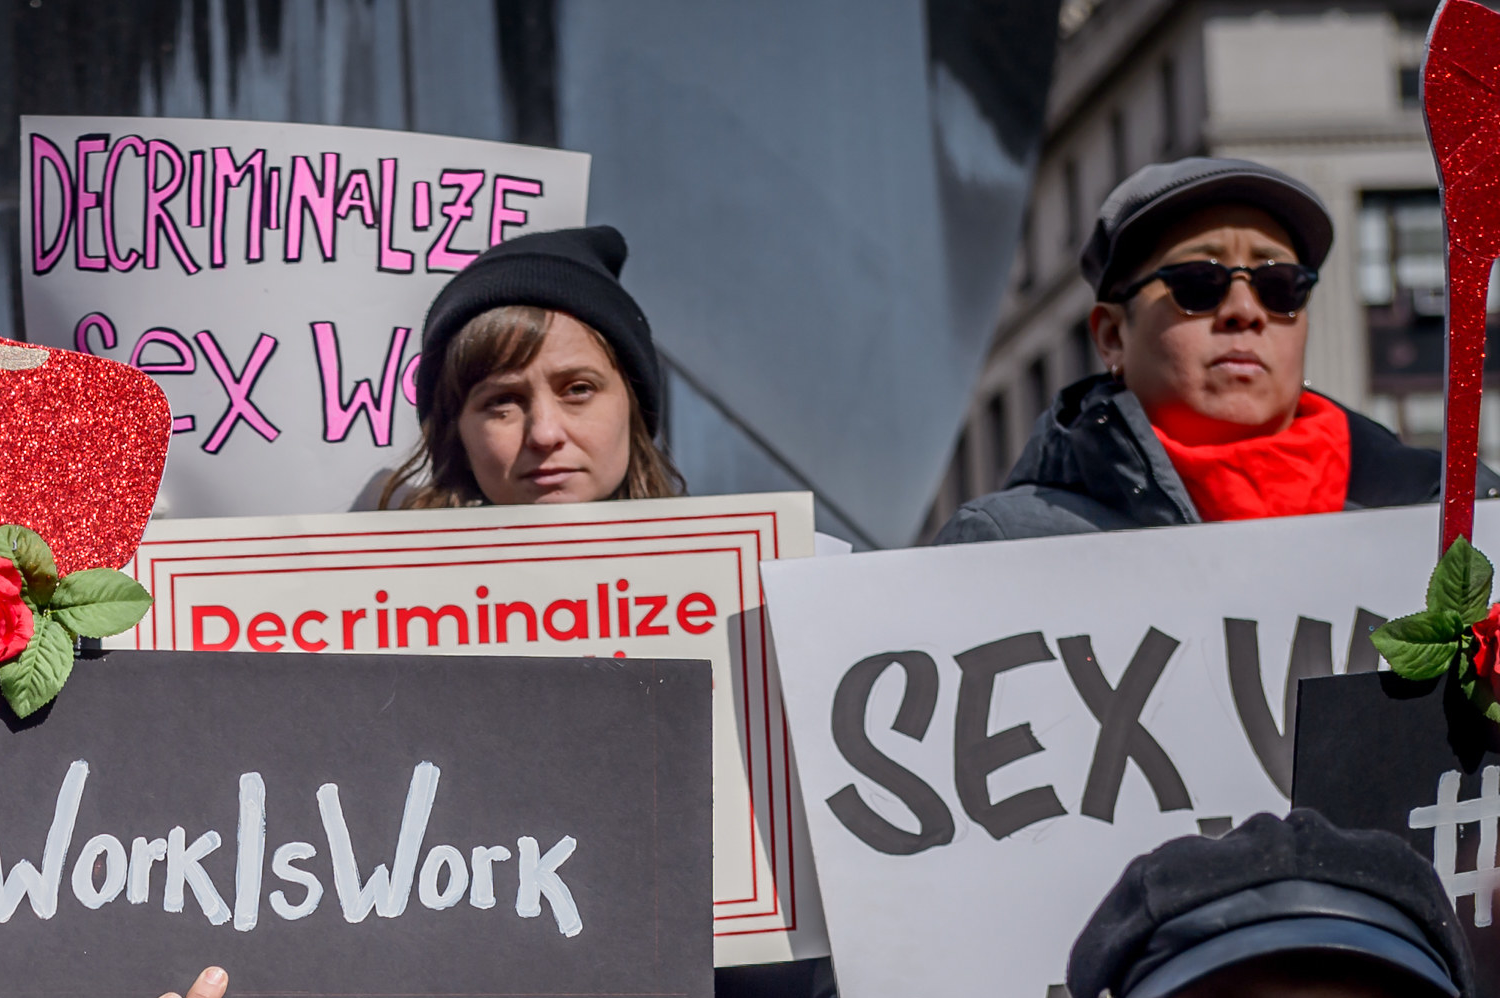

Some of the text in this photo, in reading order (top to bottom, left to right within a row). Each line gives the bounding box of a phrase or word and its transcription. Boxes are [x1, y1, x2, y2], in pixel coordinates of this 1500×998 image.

[29, 132, 544, 275] DECRIMINALIZE
[191, 577, 718, 654] Decriminalize
[824, 625, 1195, 857] SEX
